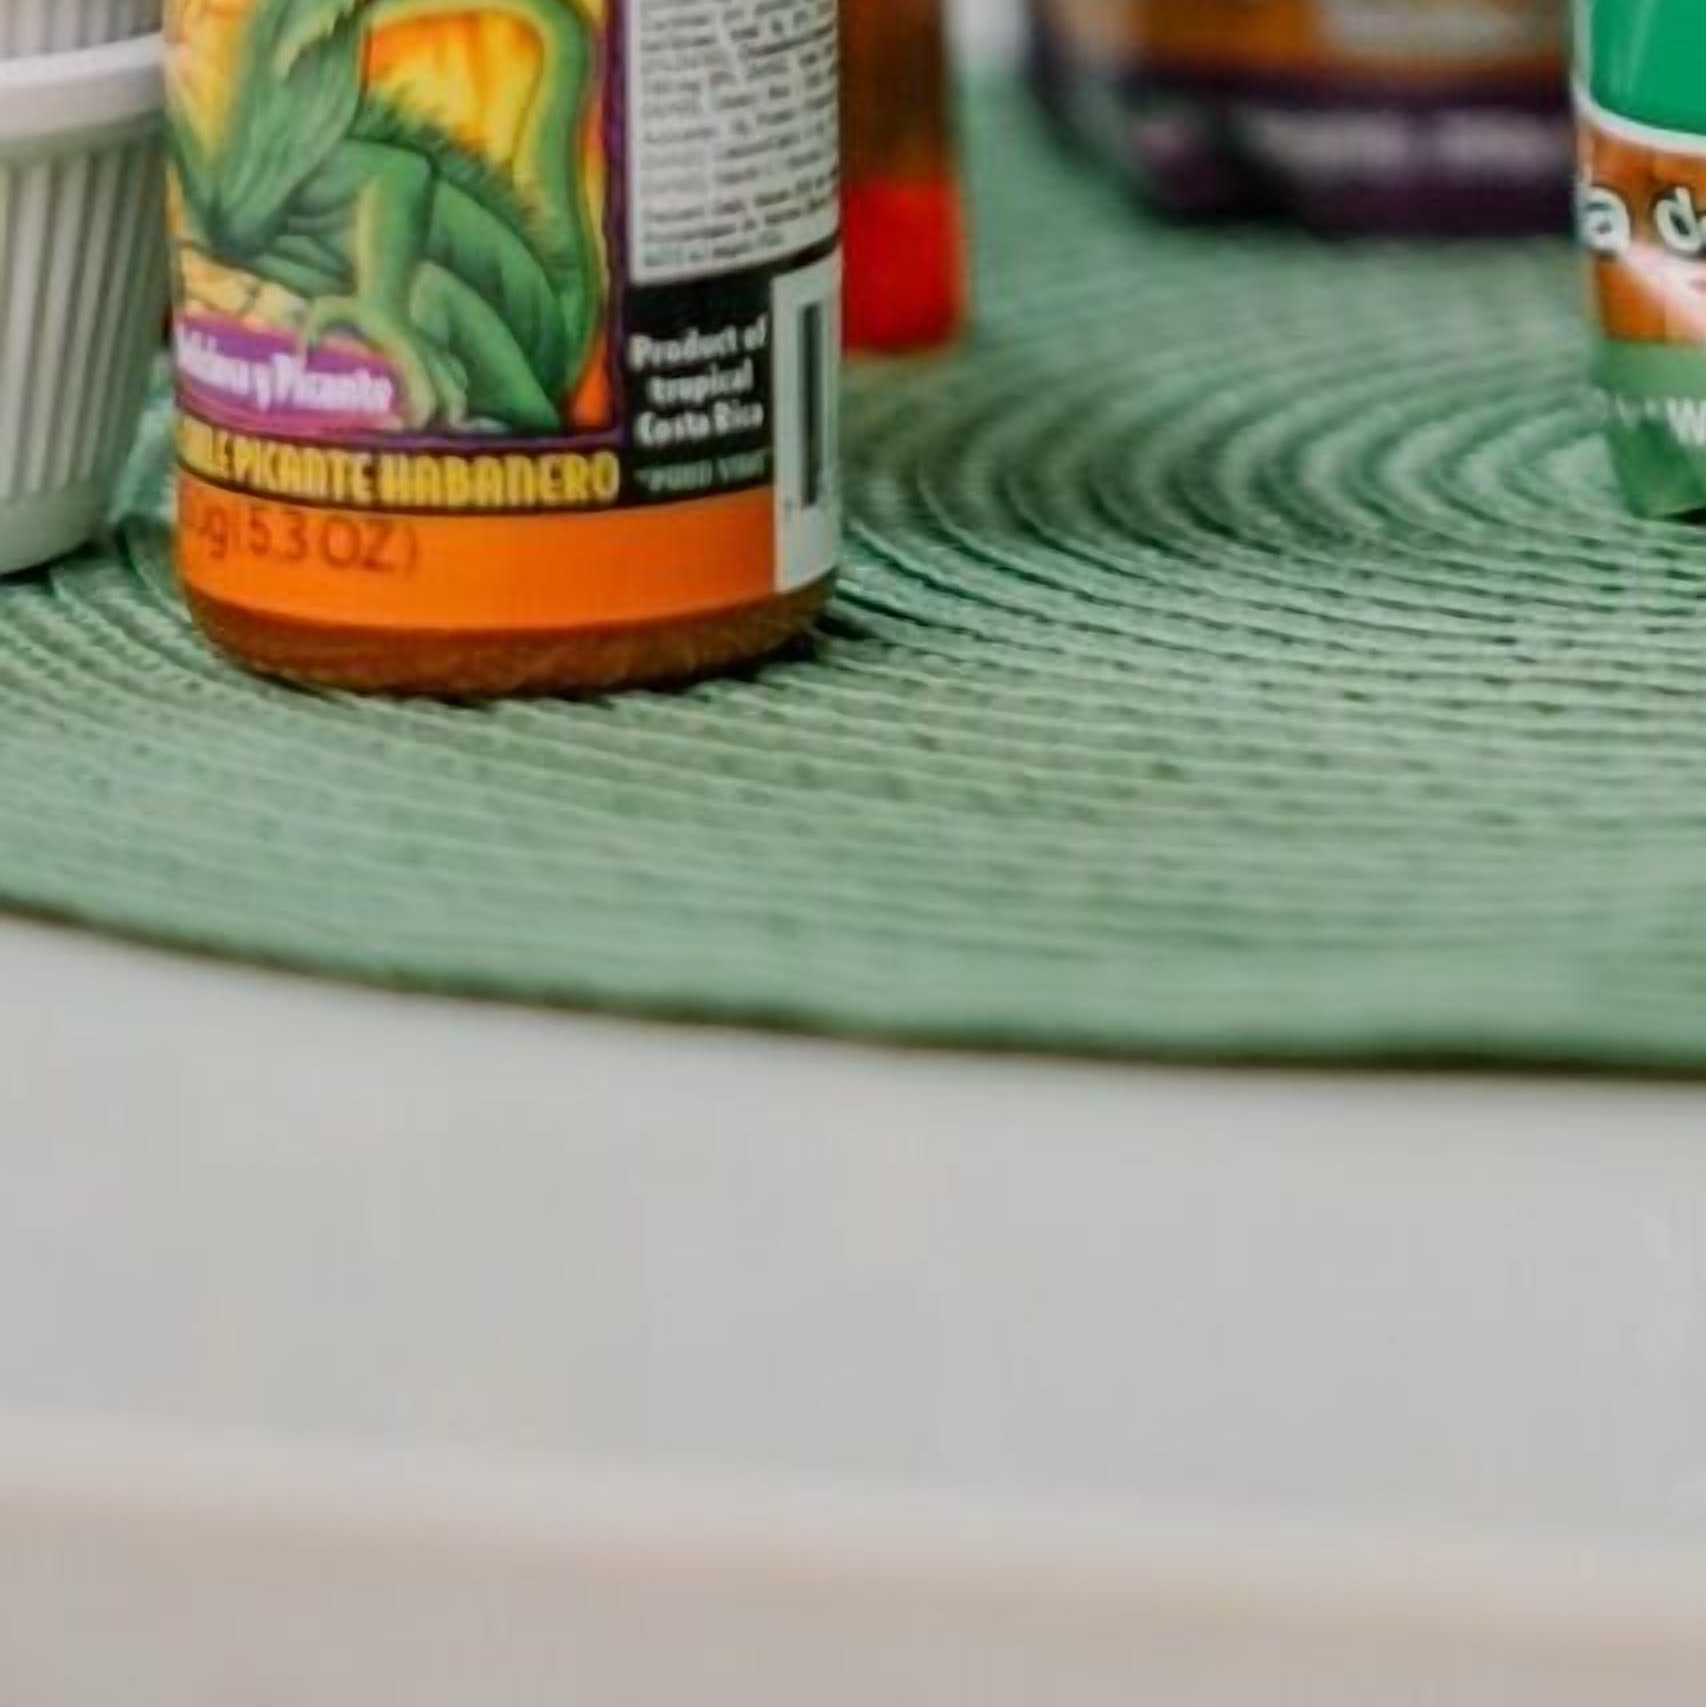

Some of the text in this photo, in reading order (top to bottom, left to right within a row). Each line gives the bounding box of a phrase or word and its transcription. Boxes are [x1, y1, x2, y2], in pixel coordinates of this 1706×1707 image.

[629, 313, 769, 371] Product of
[271, 352, 395, 414] Picante
[647, 357, 755, 406] tropical
[634, 400, 765, 447] Costa Rica
[231, 436, 376, 502] PICANTE
[379, 450, 620, 505] HABANERO
